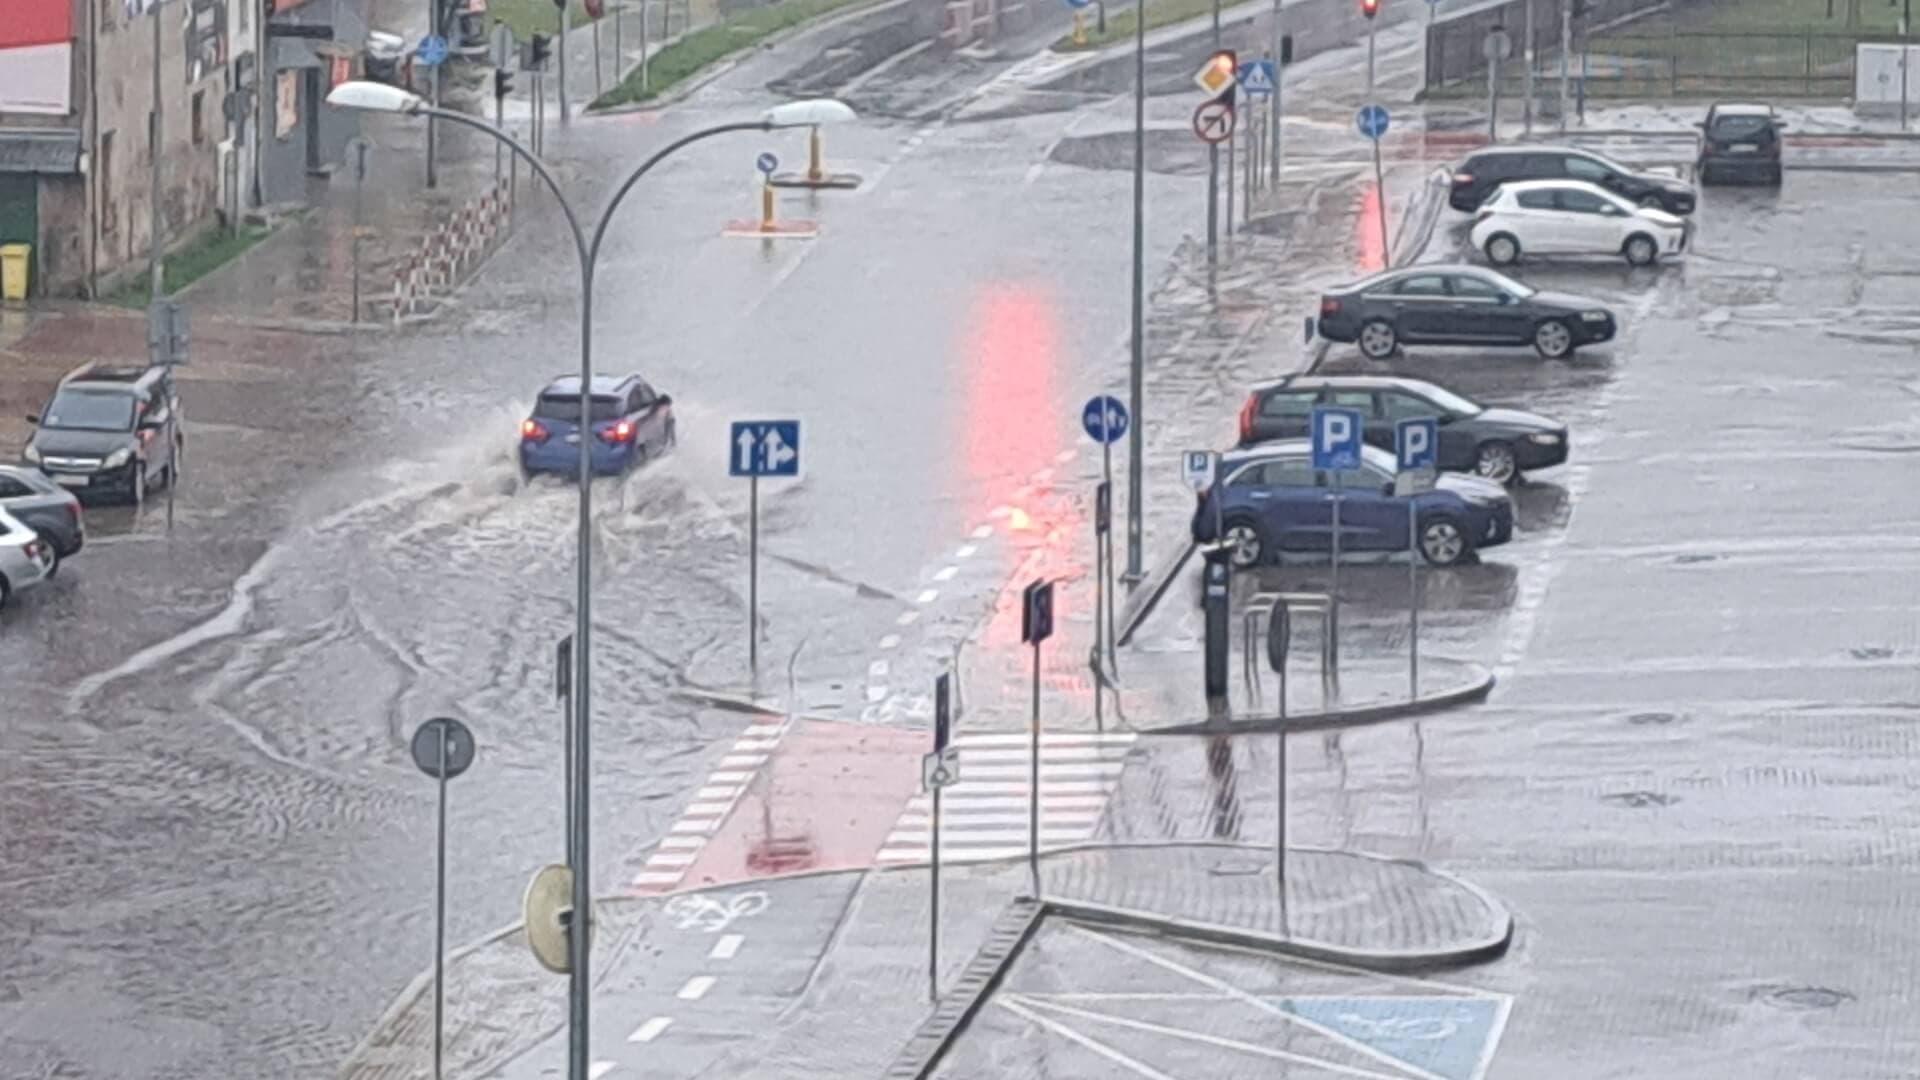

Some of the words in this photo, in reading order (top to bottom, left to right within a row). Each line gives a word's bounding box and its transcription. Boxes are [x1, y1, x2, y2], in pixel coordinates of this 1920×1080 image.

[1323, 413, 1351, 453] P
[1404, 425, 1428, 465] P
[1193, 455, 1205, 468] P
